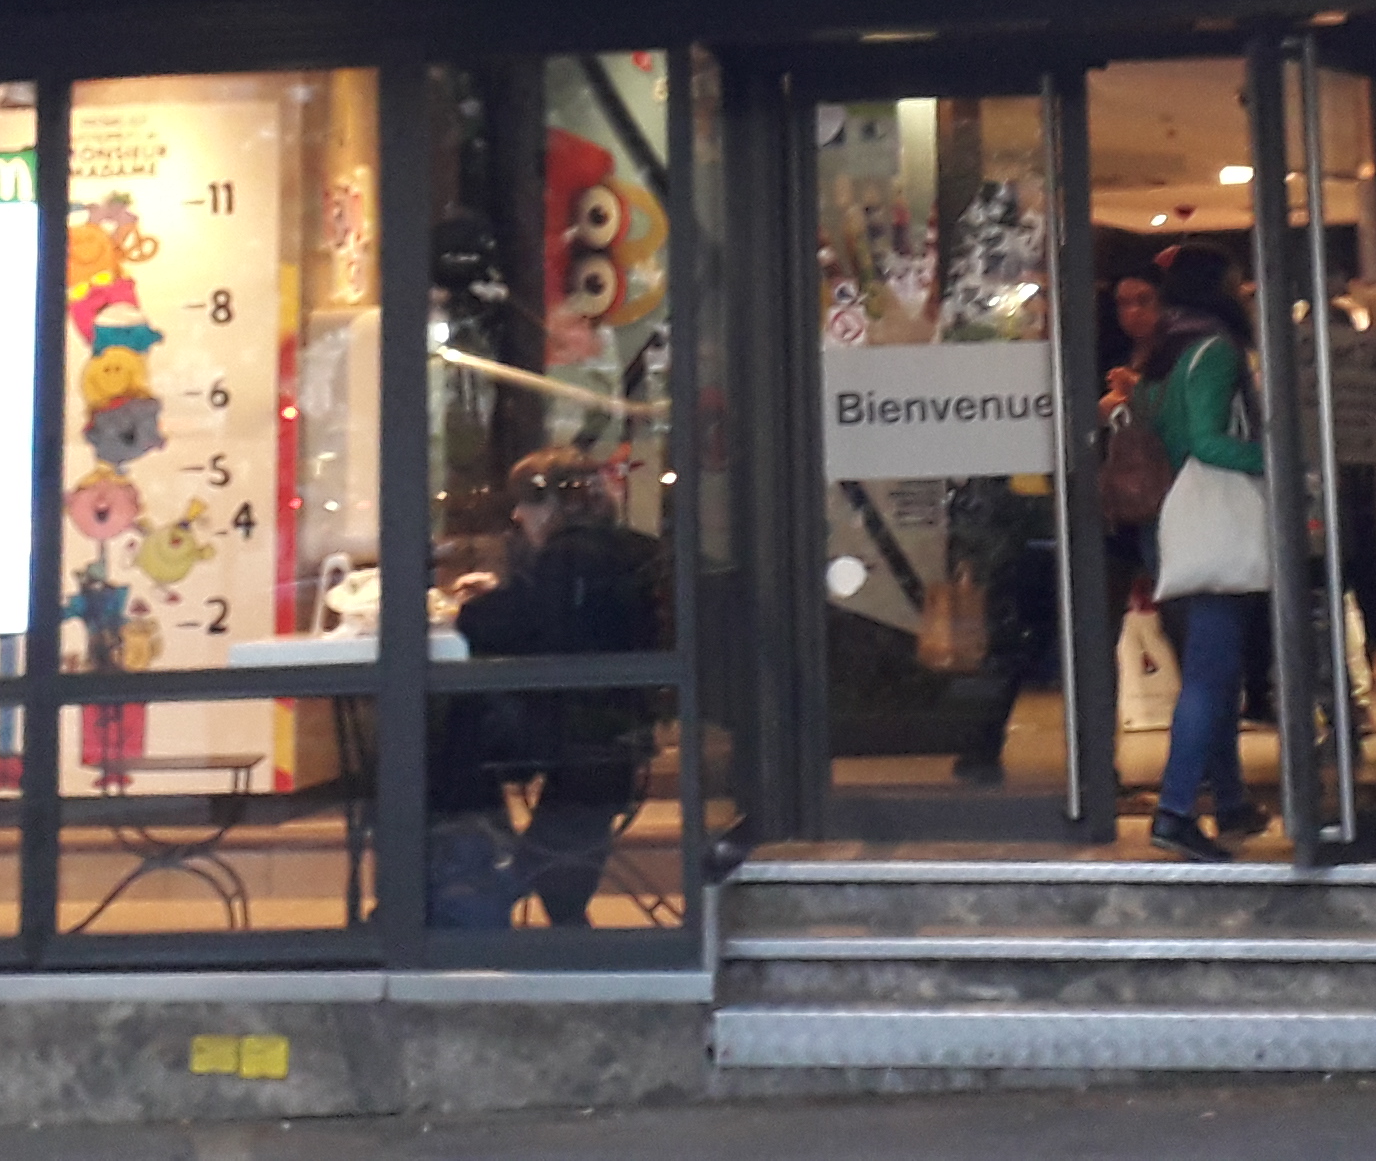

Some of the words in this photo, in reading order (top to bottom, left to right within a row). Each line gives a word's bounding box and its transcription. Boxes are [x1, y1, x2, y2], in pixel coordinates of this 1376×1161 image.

[208, 182, 233, 214] 11
[211, 289, 233, 324] 8
[210, 376, 230, 408] 6
[837, 391, 1054, 425] Bienvenue
[209, 452, 231, 487] 5
[232, 501, 256, 539] 4
[205, 597, 228, 635] 2
